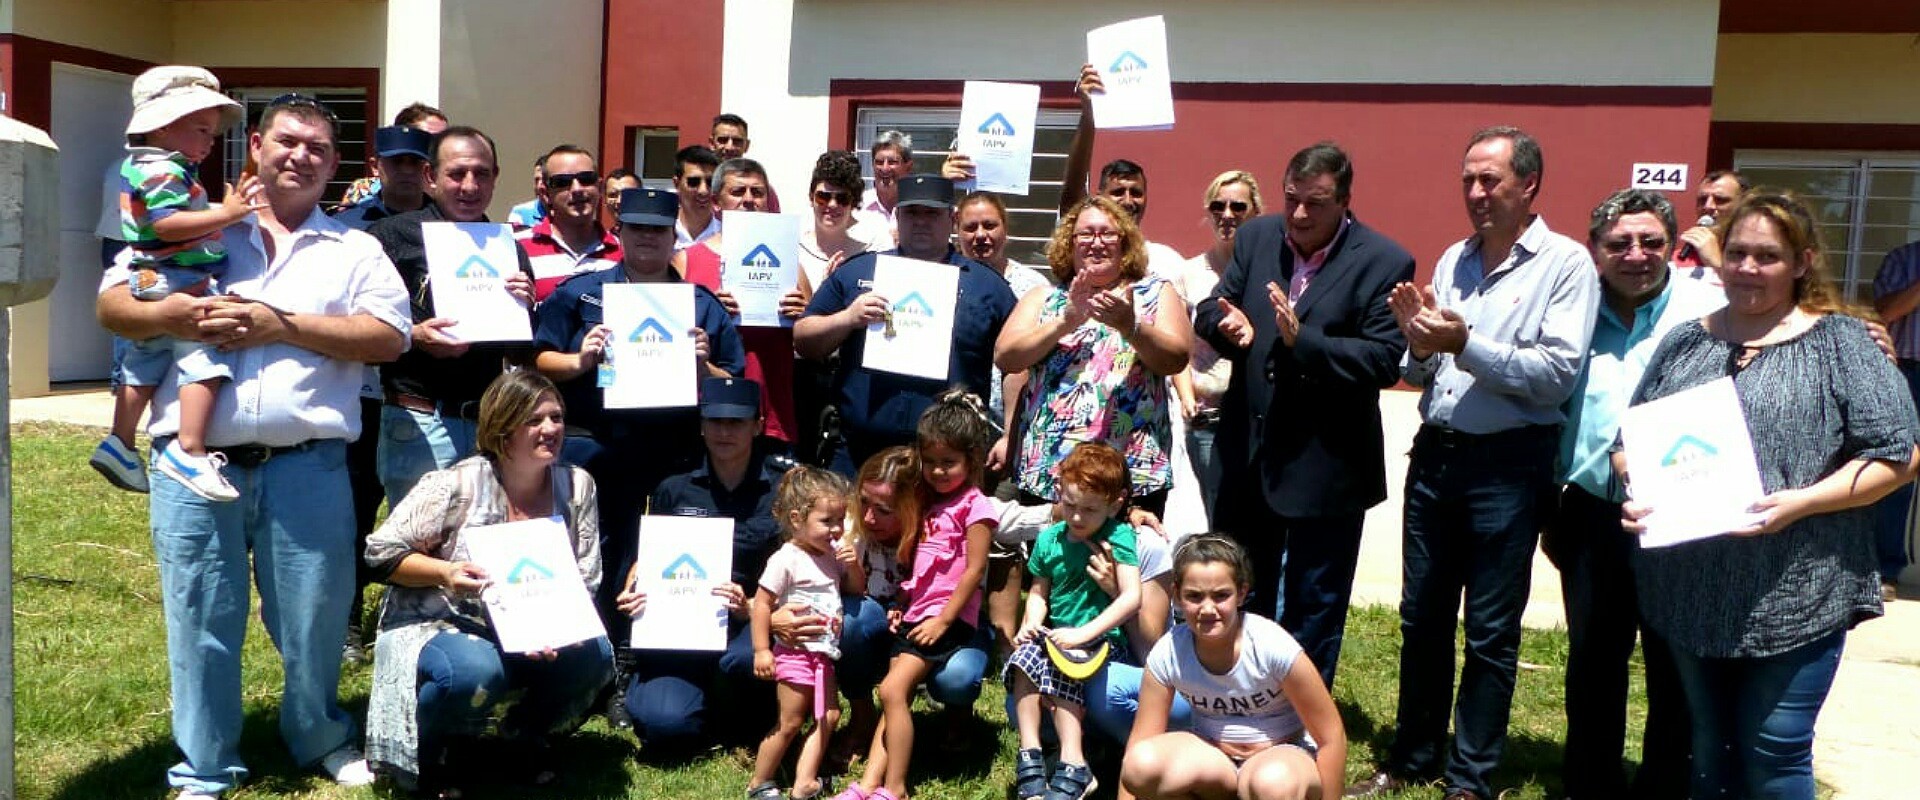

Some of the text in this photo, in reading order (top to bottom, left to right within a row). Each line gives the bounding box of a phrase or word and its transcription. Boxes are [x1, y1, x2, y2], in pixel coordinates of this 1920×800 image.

[983, 139, 1006, 148] IAPV
[1636, 168, 1682, 185] 244
[748, 272, 773, 280] IAPV
[466, 283, 493, 292] IAPV
[670, 586, 697, 596] IAPV
